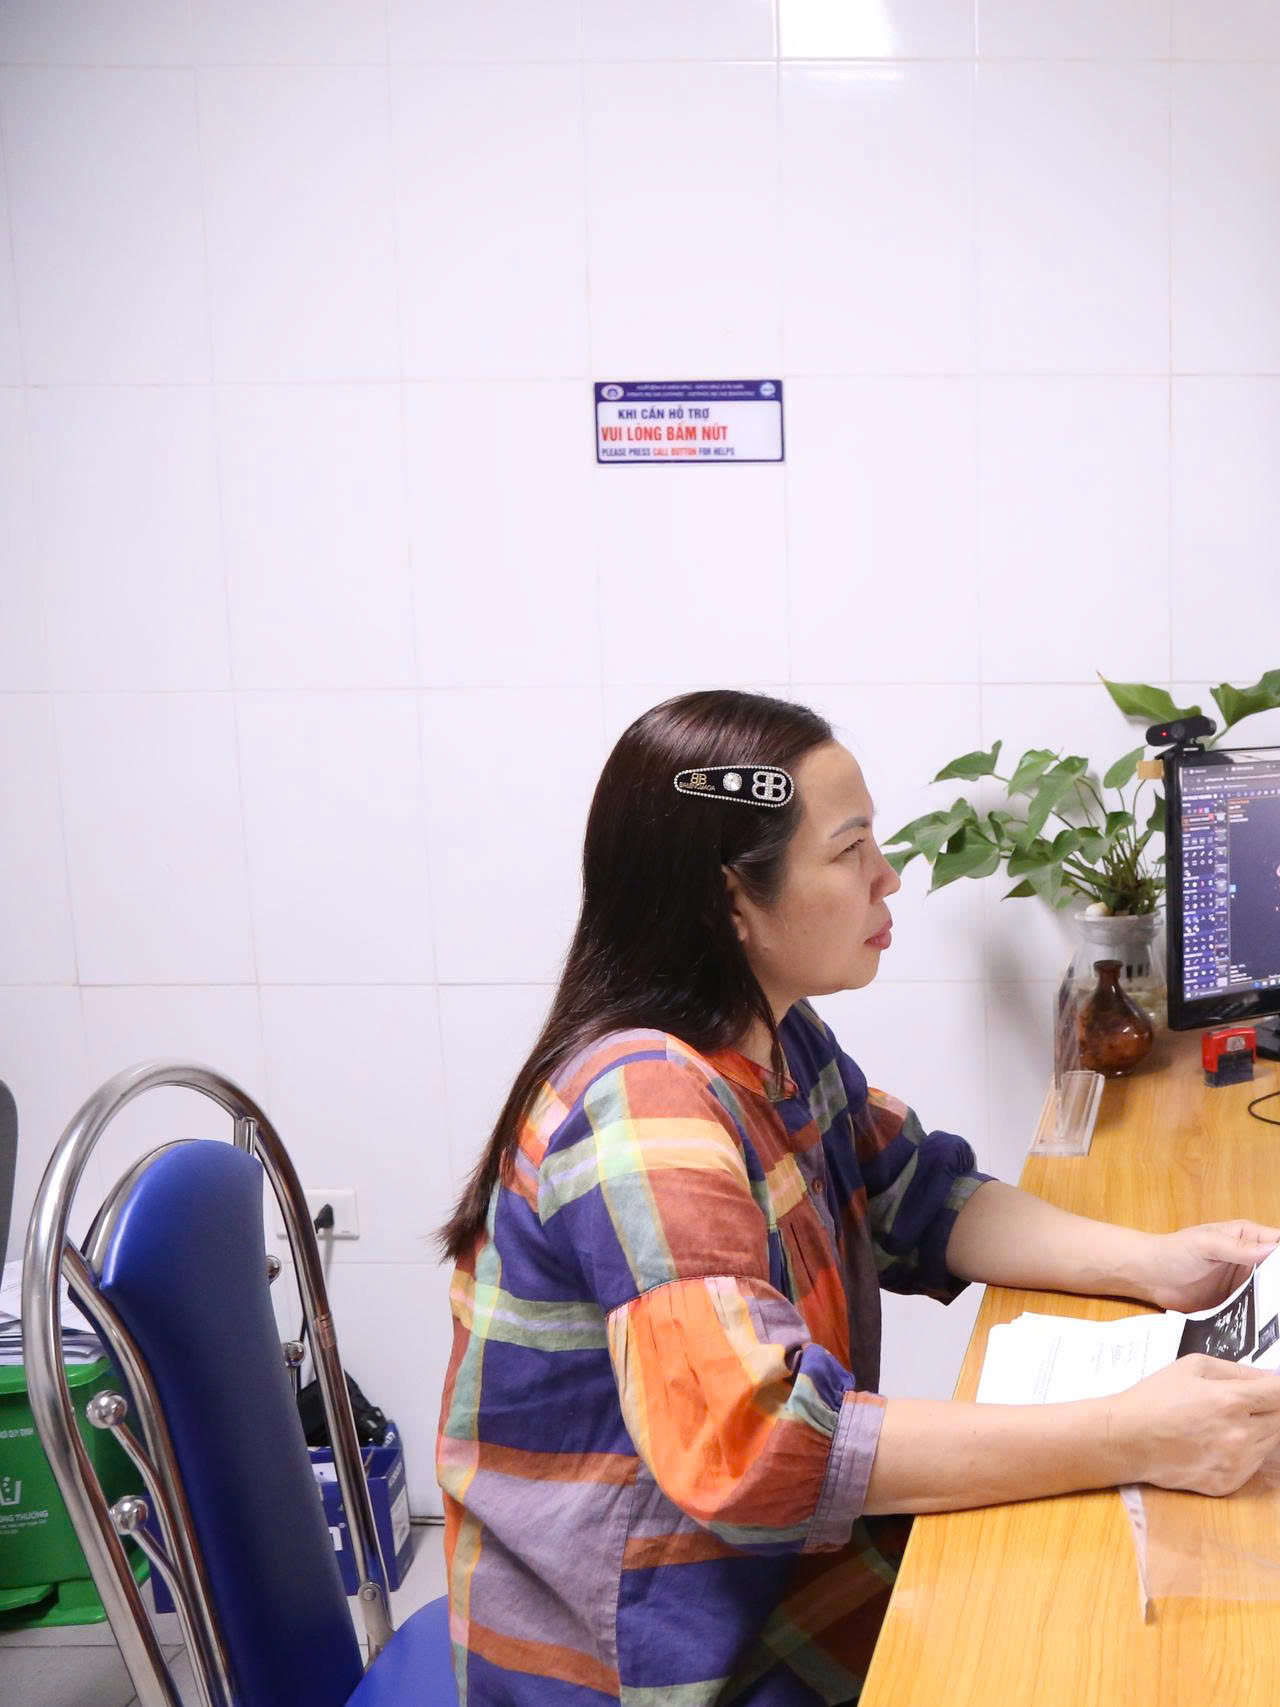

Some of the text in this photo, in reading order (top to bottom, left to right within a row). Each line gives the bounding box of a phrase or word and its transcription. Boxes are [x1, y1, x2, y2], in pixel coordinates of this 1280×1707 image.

[618, 408, 637, 420] KHI
[601, 420, 728, 441] VUI LÒNG BẤM NÚT
[602, 447, 735, 457] PLEASE PRESS CALL BUTTON FOR HELPS
